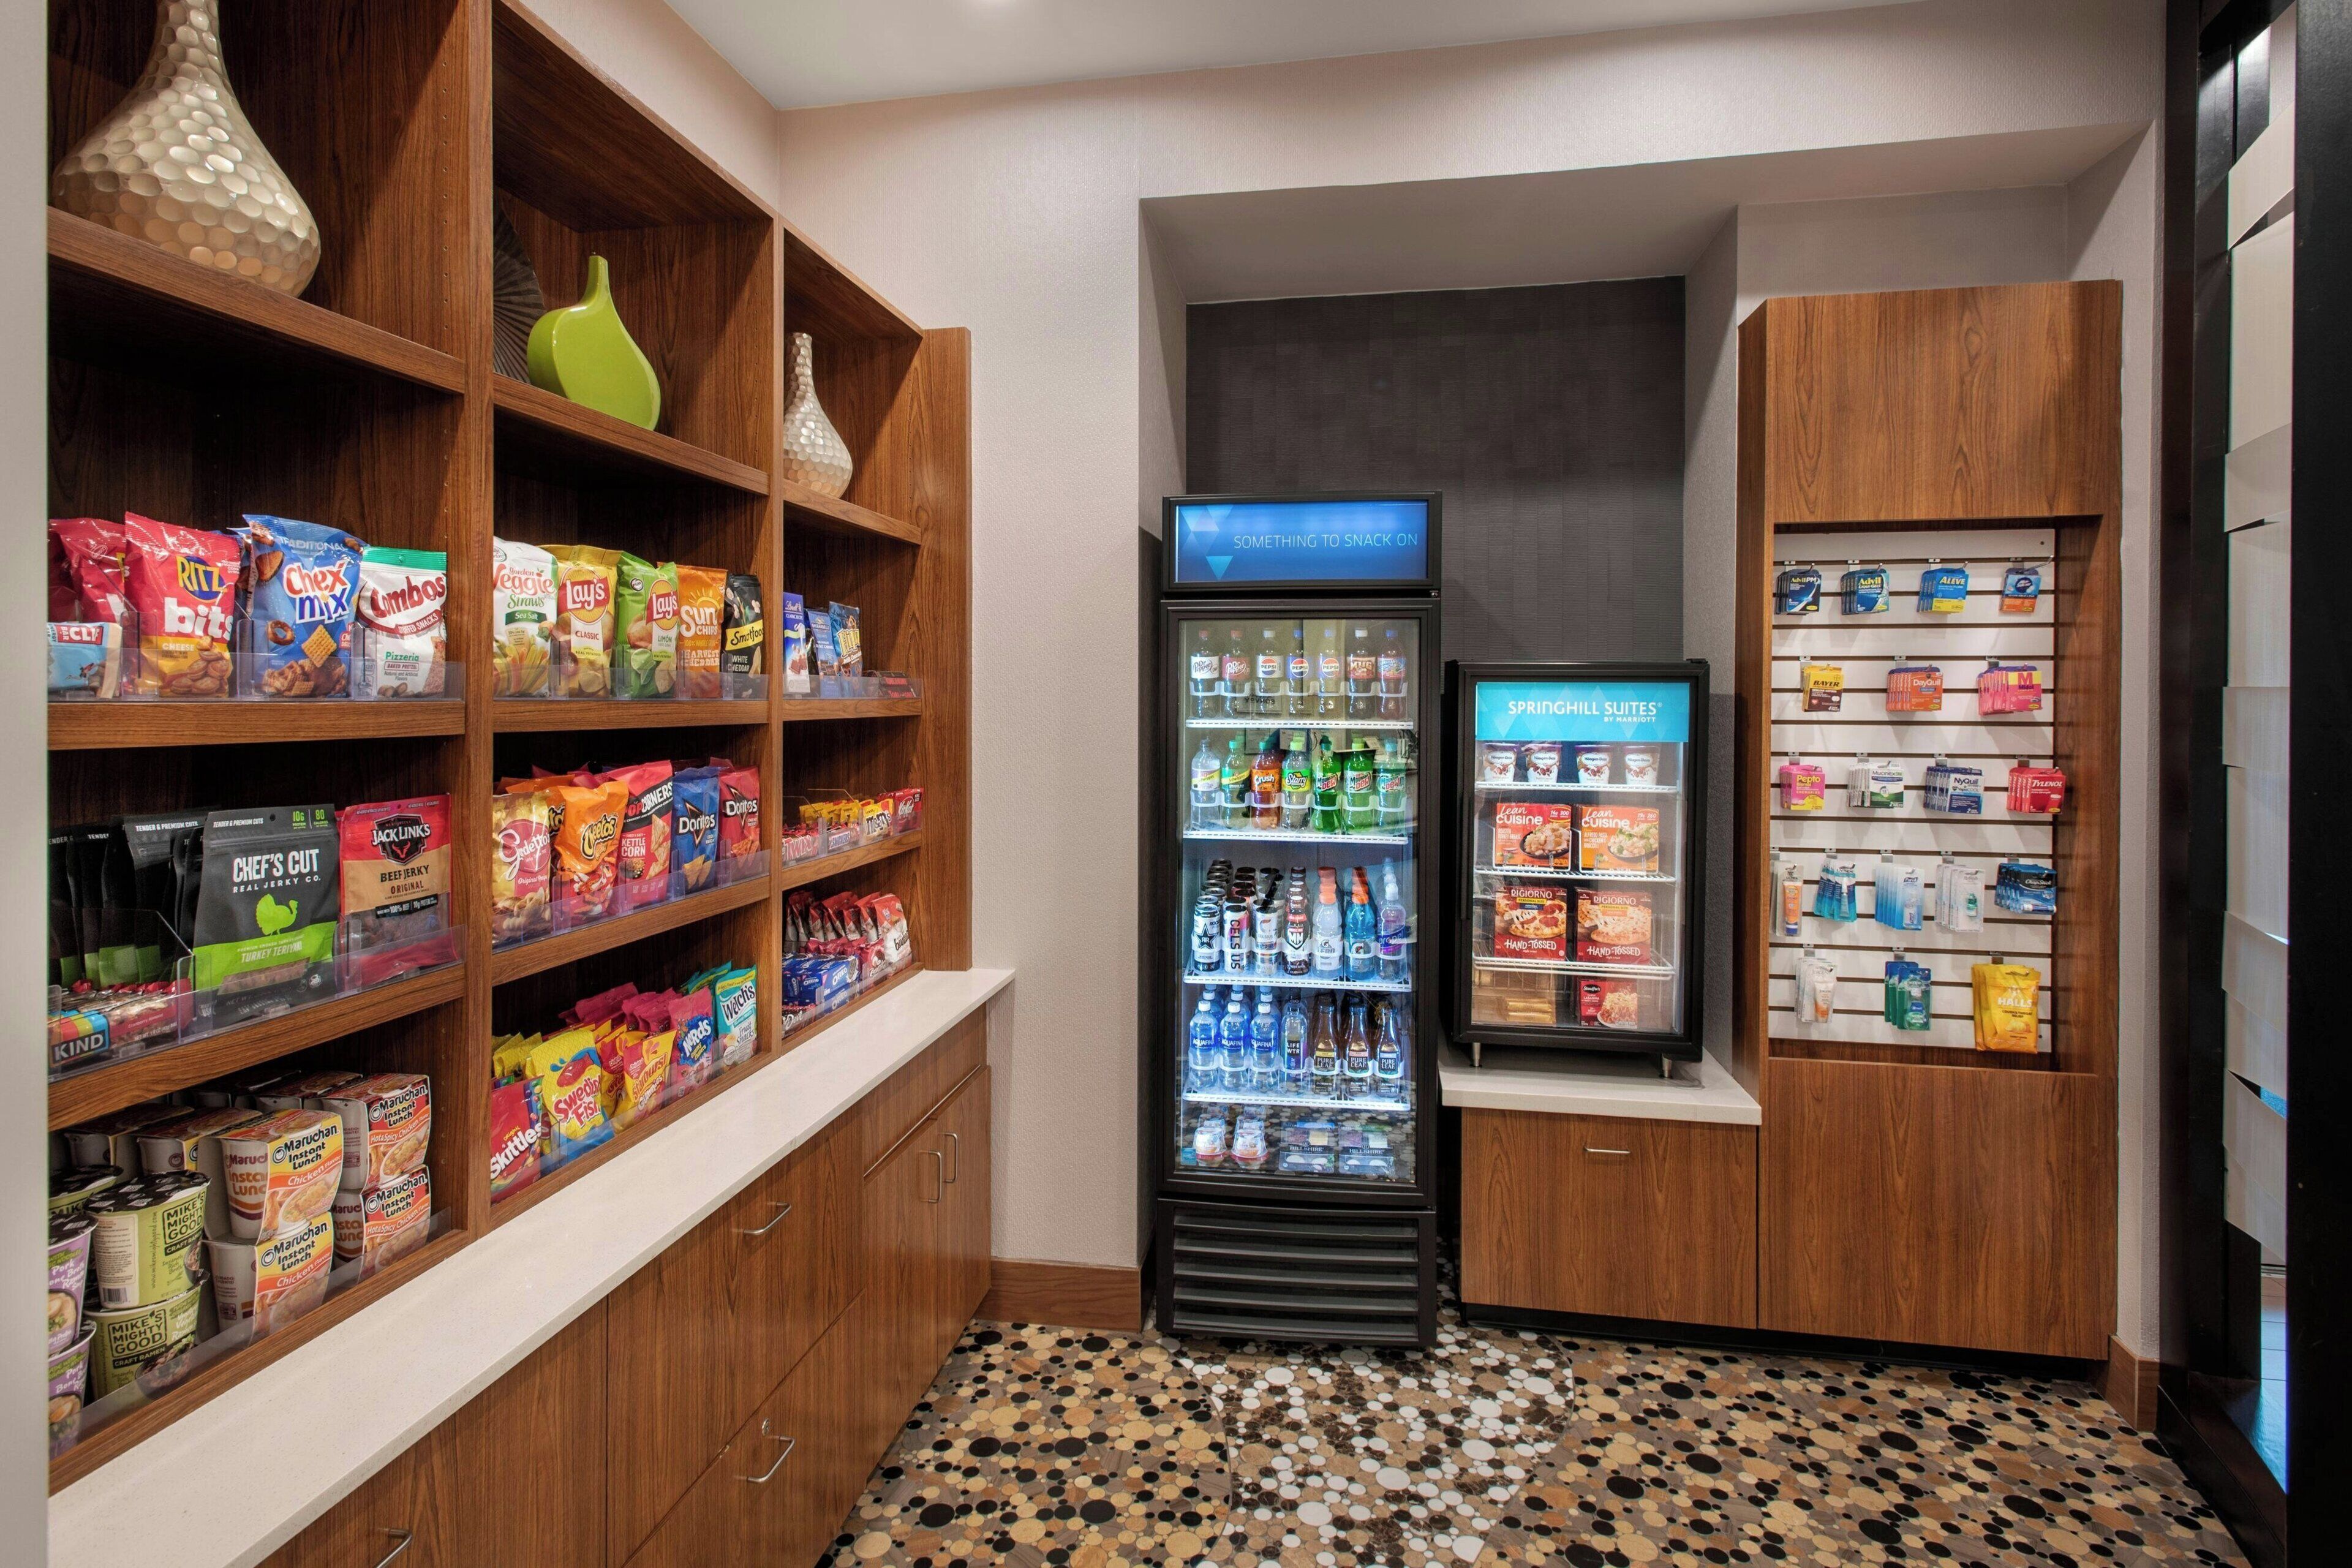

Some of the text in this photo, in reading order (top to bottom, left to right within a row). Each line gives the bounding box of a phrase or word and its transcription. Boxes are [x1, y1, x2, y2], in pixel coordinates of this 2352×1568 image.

[278, 537, 348, 552] TRADITIONAL
[1234, 533, 1418, 549] SOMETHING TO SNACK ON
[176, 555, 227, 593] RITZ
[284, 560, 348, 595] Chex
[509, 566, 534, 576] garden
[1859, 576, 1882, 585] Advil
[1939, 576, 1966, 586] ALEVE
[371, 575, 445, 619] Combos
[507, 593, 545, 609] Straws
[566, 579, 606, 611] Lay's
[296, 588, 350, 622] mix
[652, 592, 678, 620] Lay's
[164, 597, 234, 641] bits
[398, 613, 439, 634] STUFFED SNACKS
[527, 612, 538, 621] Salt
[680, 605, 718, 638] Sun
[575, 630, 600, 641] CLASSIC
[657, 635, 673, 643] LIMÓN
[696, 625, 718, 636] CHIPS
[162, 643, 195, 652] CHEESE
[385, 651, 420, 662] Pizzeria
[732, 655, 748, 663] WHITE
[1349, 660, 1373, 670] MUG
[727, 663, 750, 673] CHEDDAR
[1194, 662, 1212, 673] Pepper
[2018, 672, 2034, 685] M
[1508, 701, 1600, 715] SPRINGHILL
[1255, 774, 1275, 785] Crush
[1286, 774, 1307, 788] Starry
[1322, 777, 1338, 790] DEW
[1355, 776, 1371, 790] DEW
[1385, 775, 1401, 790] DEW
[1796, 774, 1821, 784] Pepto
[1954, 777, 1978, 786] NyQuil
[315, 809, 325, 820] 80
[726, 799, 758, 816] Doritos
[1499, 805, 1528, 816] Lean
[1586, 808, 1614, 820] Lean
[135, 824, 156, 832] TENDER
[679, 813, 715, 834] Doritos
[372, 823, 431, 846] JACK LINK'S
[581, 816, 617, 859] Cheetos
[622, 837, 646, 846] KETTLE
[621, 846, 646, 857] CORN
[232, 848, 320, 883] CHEF'S CUT
[380, 864, 430, 883] BEEF JERKY
[233, 875, 321, 894] REAL JERKY CO.
[390, 880, 424, 895] ORIGINAL
[1511, 889, 1553, 899] DIGIORNO
[1594, 895, 1637, 905] DIGIORNO
[1504, 938, 1557, 951] HAND-TOSSED
[1586, 945, 1641, 957] HAND-TOSSED
[241, 949, 272, 963] TURKEY
[802, 978, 820, 986] OREO
[832, 967, 848, 986] OREO
[723, 985, 755, 1021] Welch's
[832, 990, 848, 1010] OREO
[1998, 997, 2033, 1008] HALLS
[739, 1021, 752, 1036] Fruit
[54, 1033, 104, 1061] KIND
[1221, 1038, 1243, 1047] AQUAFINA
[1251, 1039, 1273, 1047] AQUAFINA
[379, 1084, 427, 1112] Maruchan
[383, 1100, 417, 1121] Instant
[388, 1111, 413, 1128] Lunch
[284, 1125, 337, 1153] Maruchan
[371, 1119, 420, 1144] Hot&Spicy Chicken
[288, 1141, 326, 1164] Instant
[490, 1122, 541, 1180] Skittles
[292, 1152, 322, 1170] Lunch
[287, 1154, 342, 1186] Chicken Flavor
[232, 1182, 268, 1196] Lunc
[376, 1174, 427, 1204] Maruchan
[167, 1192, 205, 1221] MIKE'S
[380, 1191, 415, 1212] Instant
[167, 1207, 204, 1230] MIGHTY
[385, 1202, 412, 1219] Lunch
[168, 1215, 203, 1240] GOOD
[367, 1209, 419, 1235] Hot&Spicy Chicken
[166, 1240, 188, 1254] CRAFT
[273, 1223, 328, 1254] Maruchan
[278, 1240, 315, 1265] Instant
[51, 1259, 75, 1276] Pork
[276, 1251, 331, 1287] Chicken Flavor
[282, 1251, 312, 1272] Lunch
[112, 1313, 163, 1335] MIKE'S
[113, 1322, 163, 1344] MIGHTY
[115, 1332, 163, 1354] GOOD
[114, 1346, 166, 1367] CRAFT RAMEN
[66, 1360, 83, 1379] Pork
[56, 1377, 76, 1393] Bone
